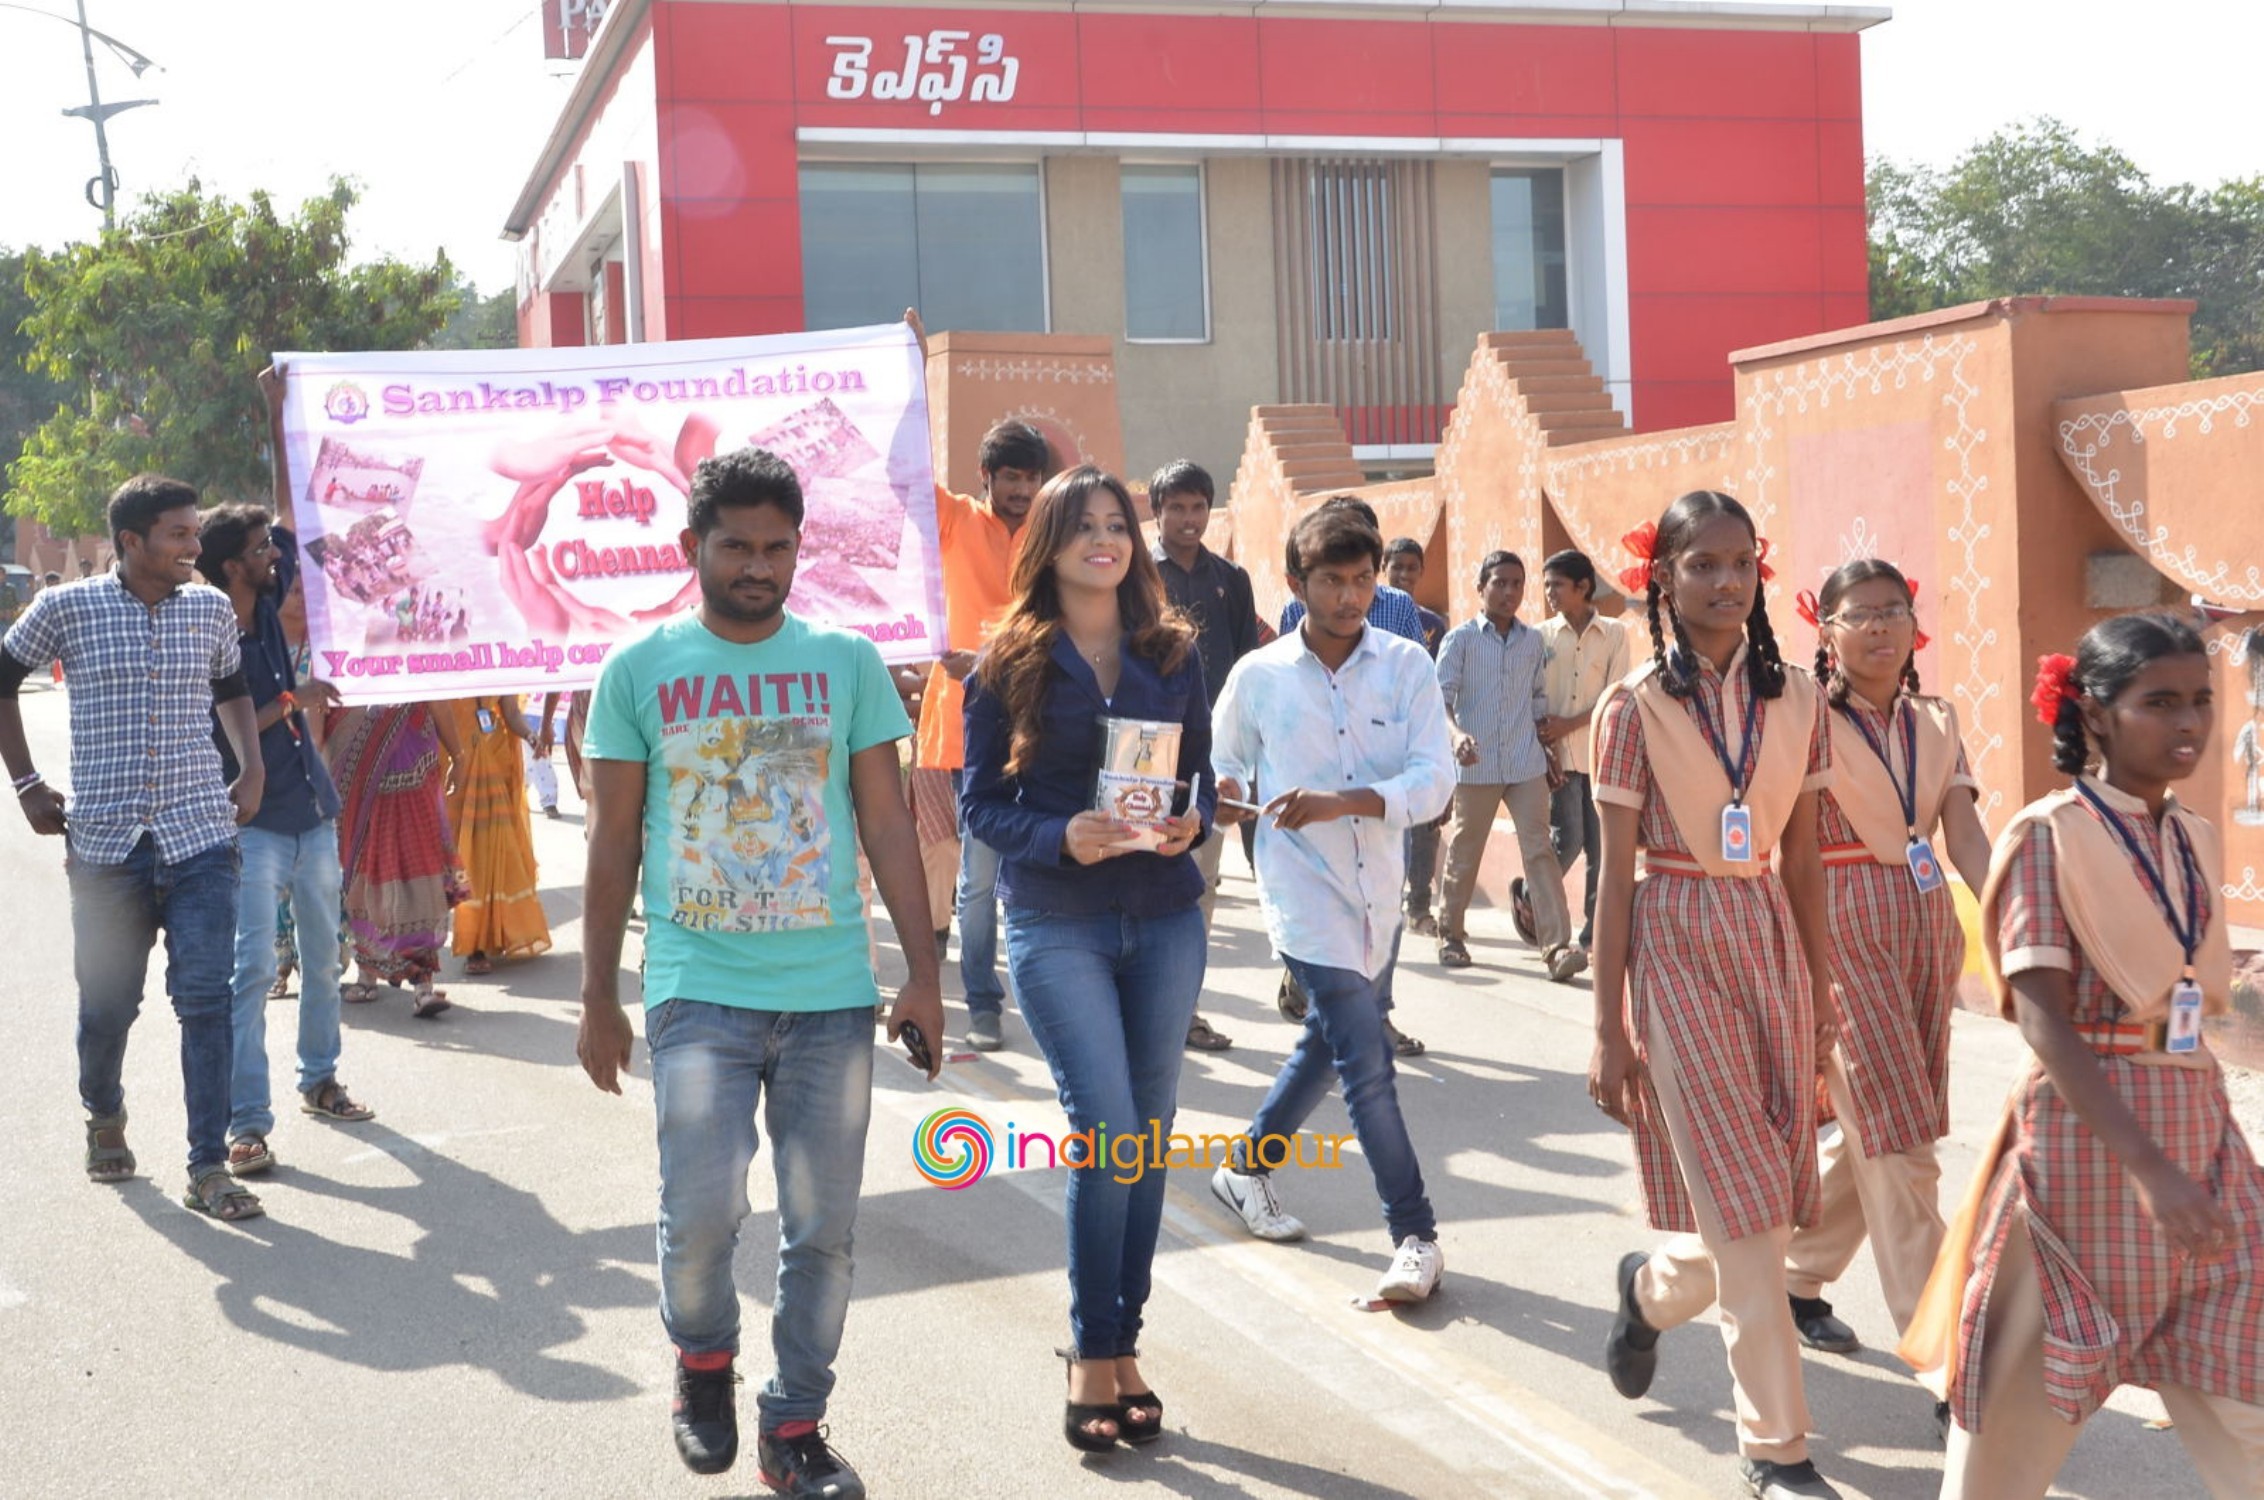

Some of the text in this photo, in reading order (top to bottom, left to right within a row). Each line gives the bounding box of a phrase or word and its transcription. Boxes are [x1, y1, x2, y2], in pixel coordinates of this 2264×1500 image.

[382, 364, 867, 416] Sankalp Foundation
[574, 477, 657, 523] Help
[322, 651, 402, 677] Your
[407, 644, 495, 674] small
[496, 639, 564, 673] help
[657, 672, 830, 724] WAIT!!
[678, 887, 738, 909] FOR
